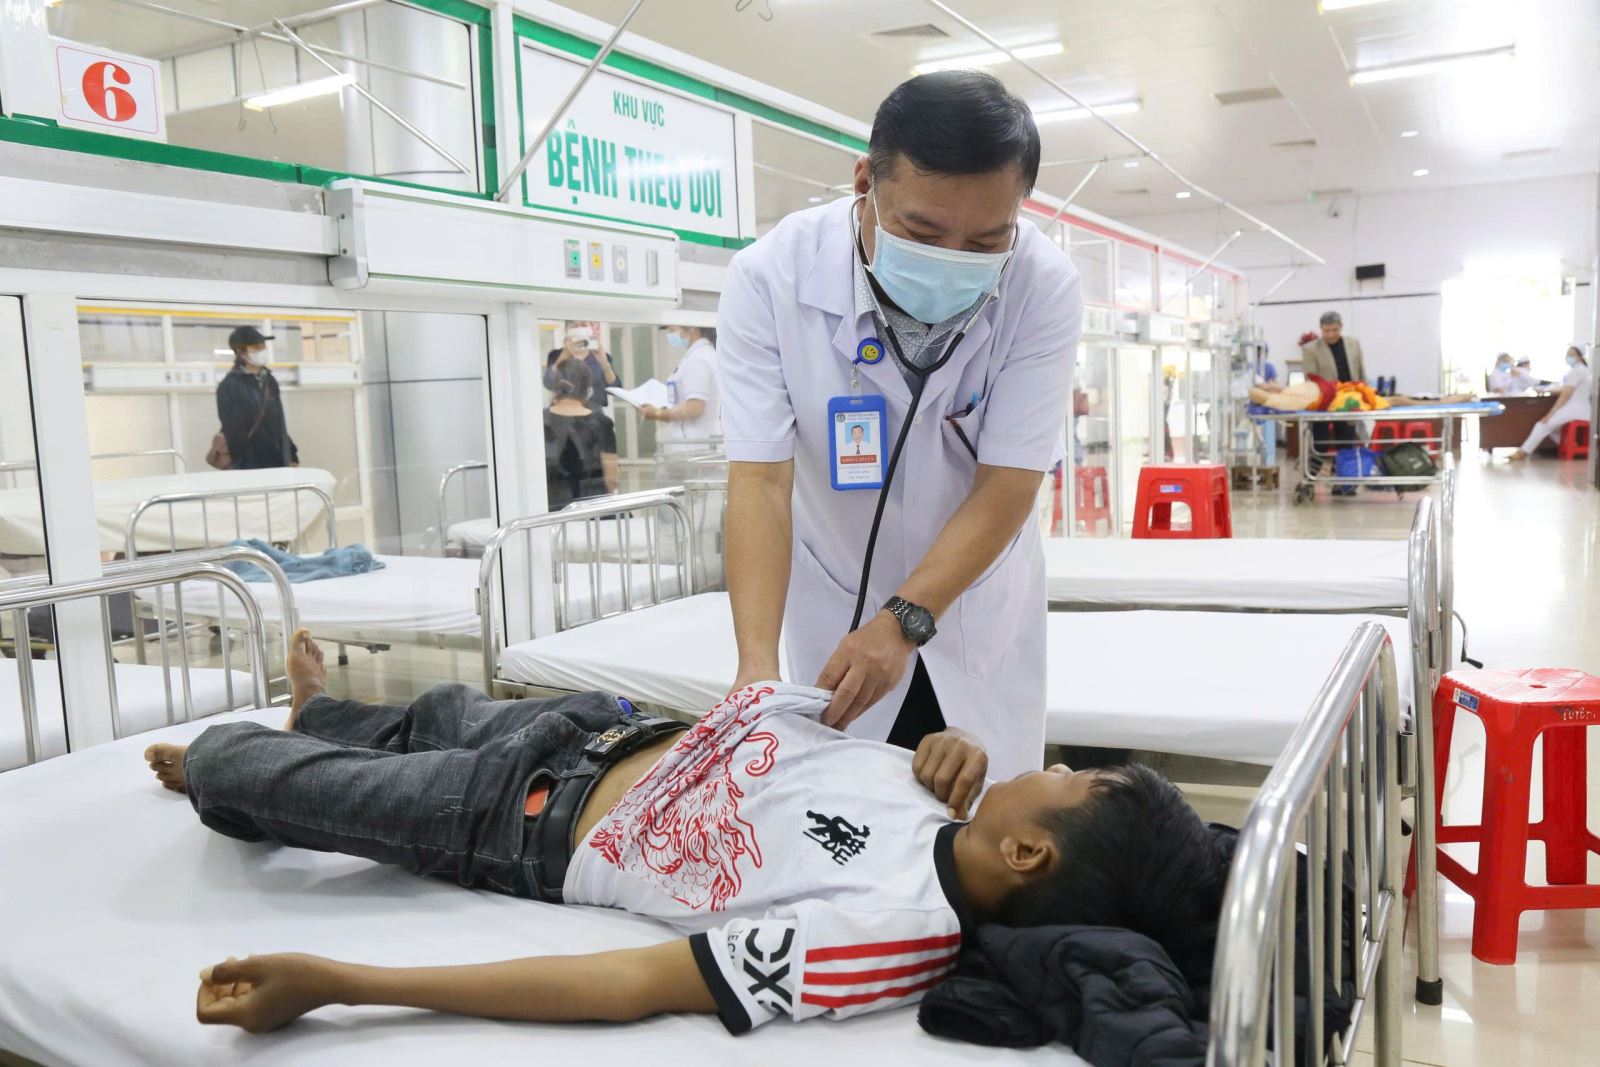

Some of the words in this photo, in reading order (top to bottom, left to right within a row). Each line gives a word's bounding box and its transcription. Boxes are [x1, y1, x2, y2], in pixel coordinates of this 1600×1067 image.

[82, 61, 137, 122] 6
[613, 90, 638, 120] KHU
[641, 99, 665, 130] VỰC
[546, 119, 618, 205] BỆNH
